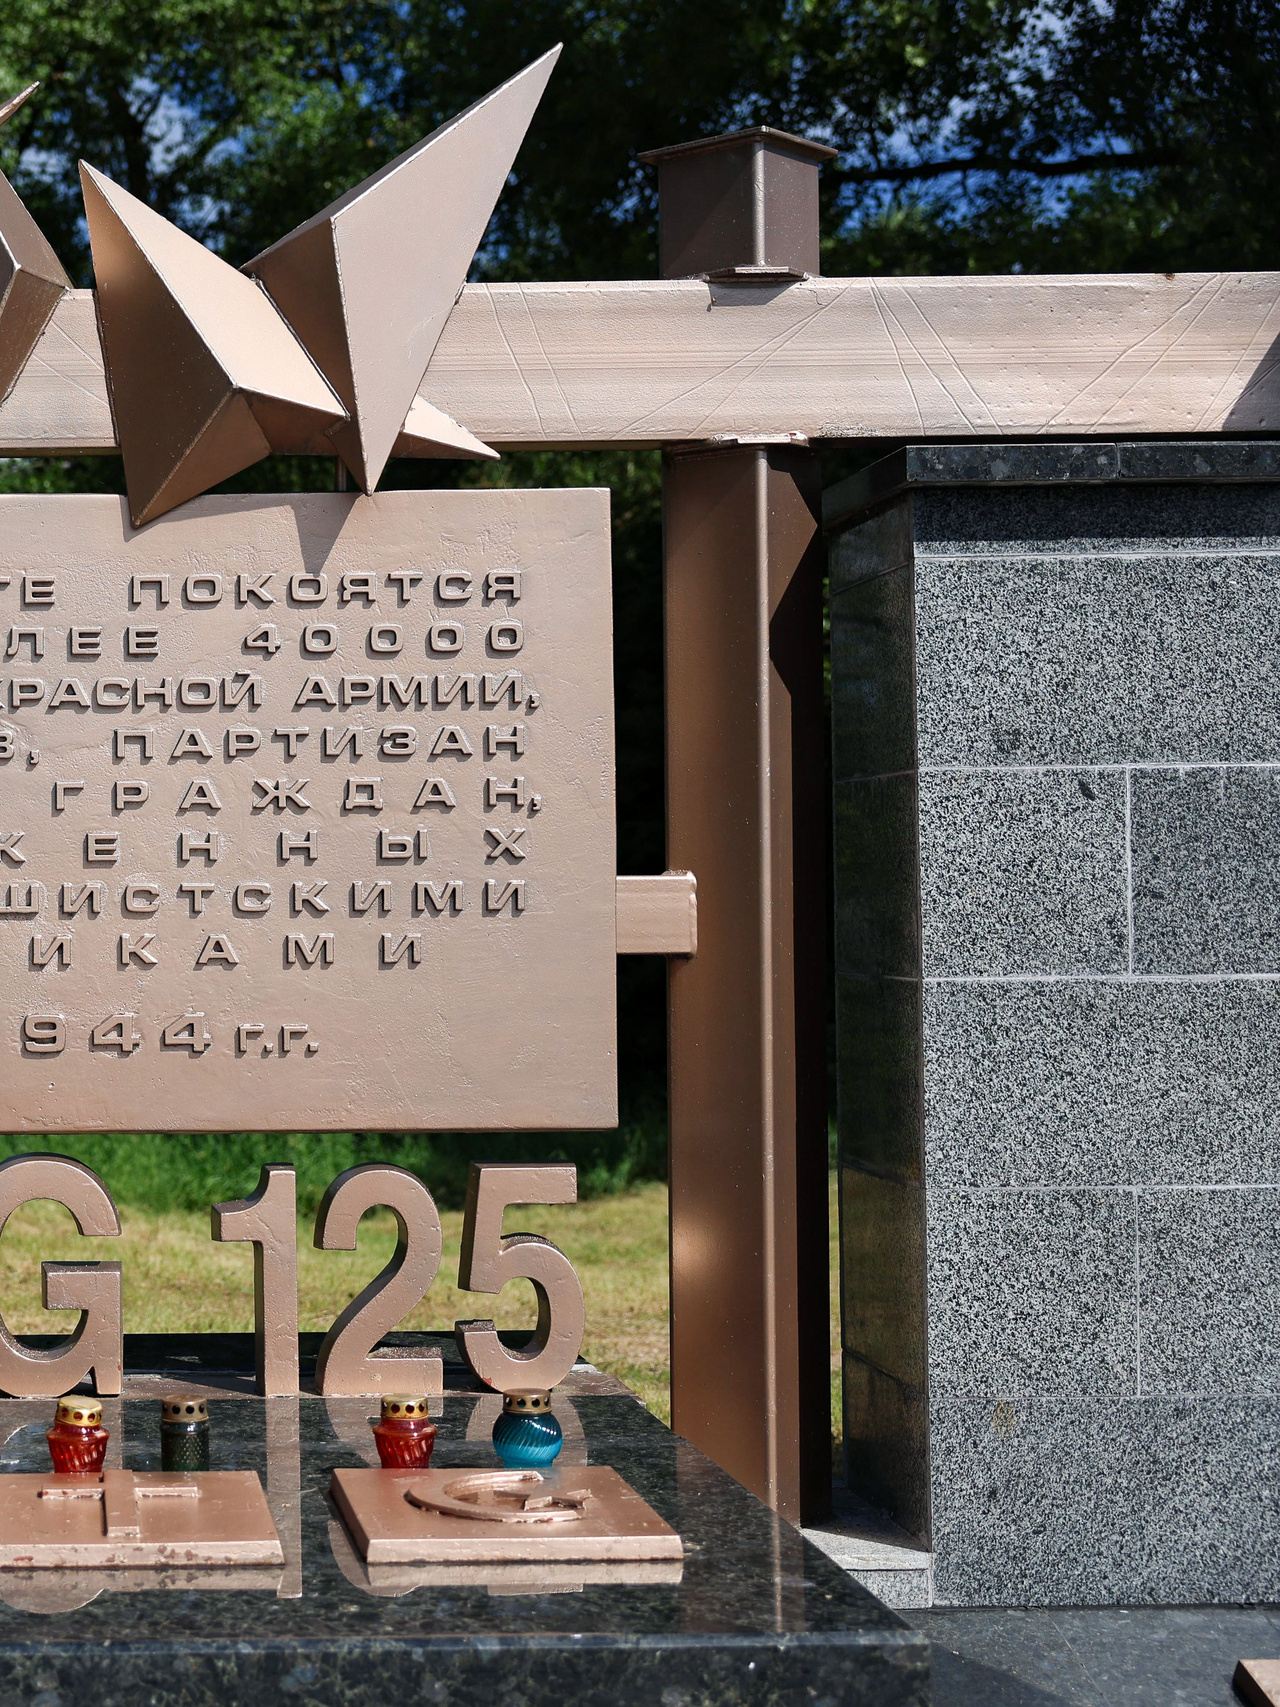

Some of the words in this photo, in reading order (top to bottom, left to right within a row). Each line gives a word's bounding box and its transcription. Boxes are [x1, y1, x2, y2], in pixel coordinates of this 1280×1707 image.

[131, 571, 523, 605] ПОКОЯТСЯ
[243, 619, 526, 654] 40000
[295, 672, 541, 709] АРМИИ,
[112, 725, 526, 761] ПАРТИЗАН
[50, 776, 543, 813] ГРАЖДАН,
[211, 1159, 586, 1398] 125
